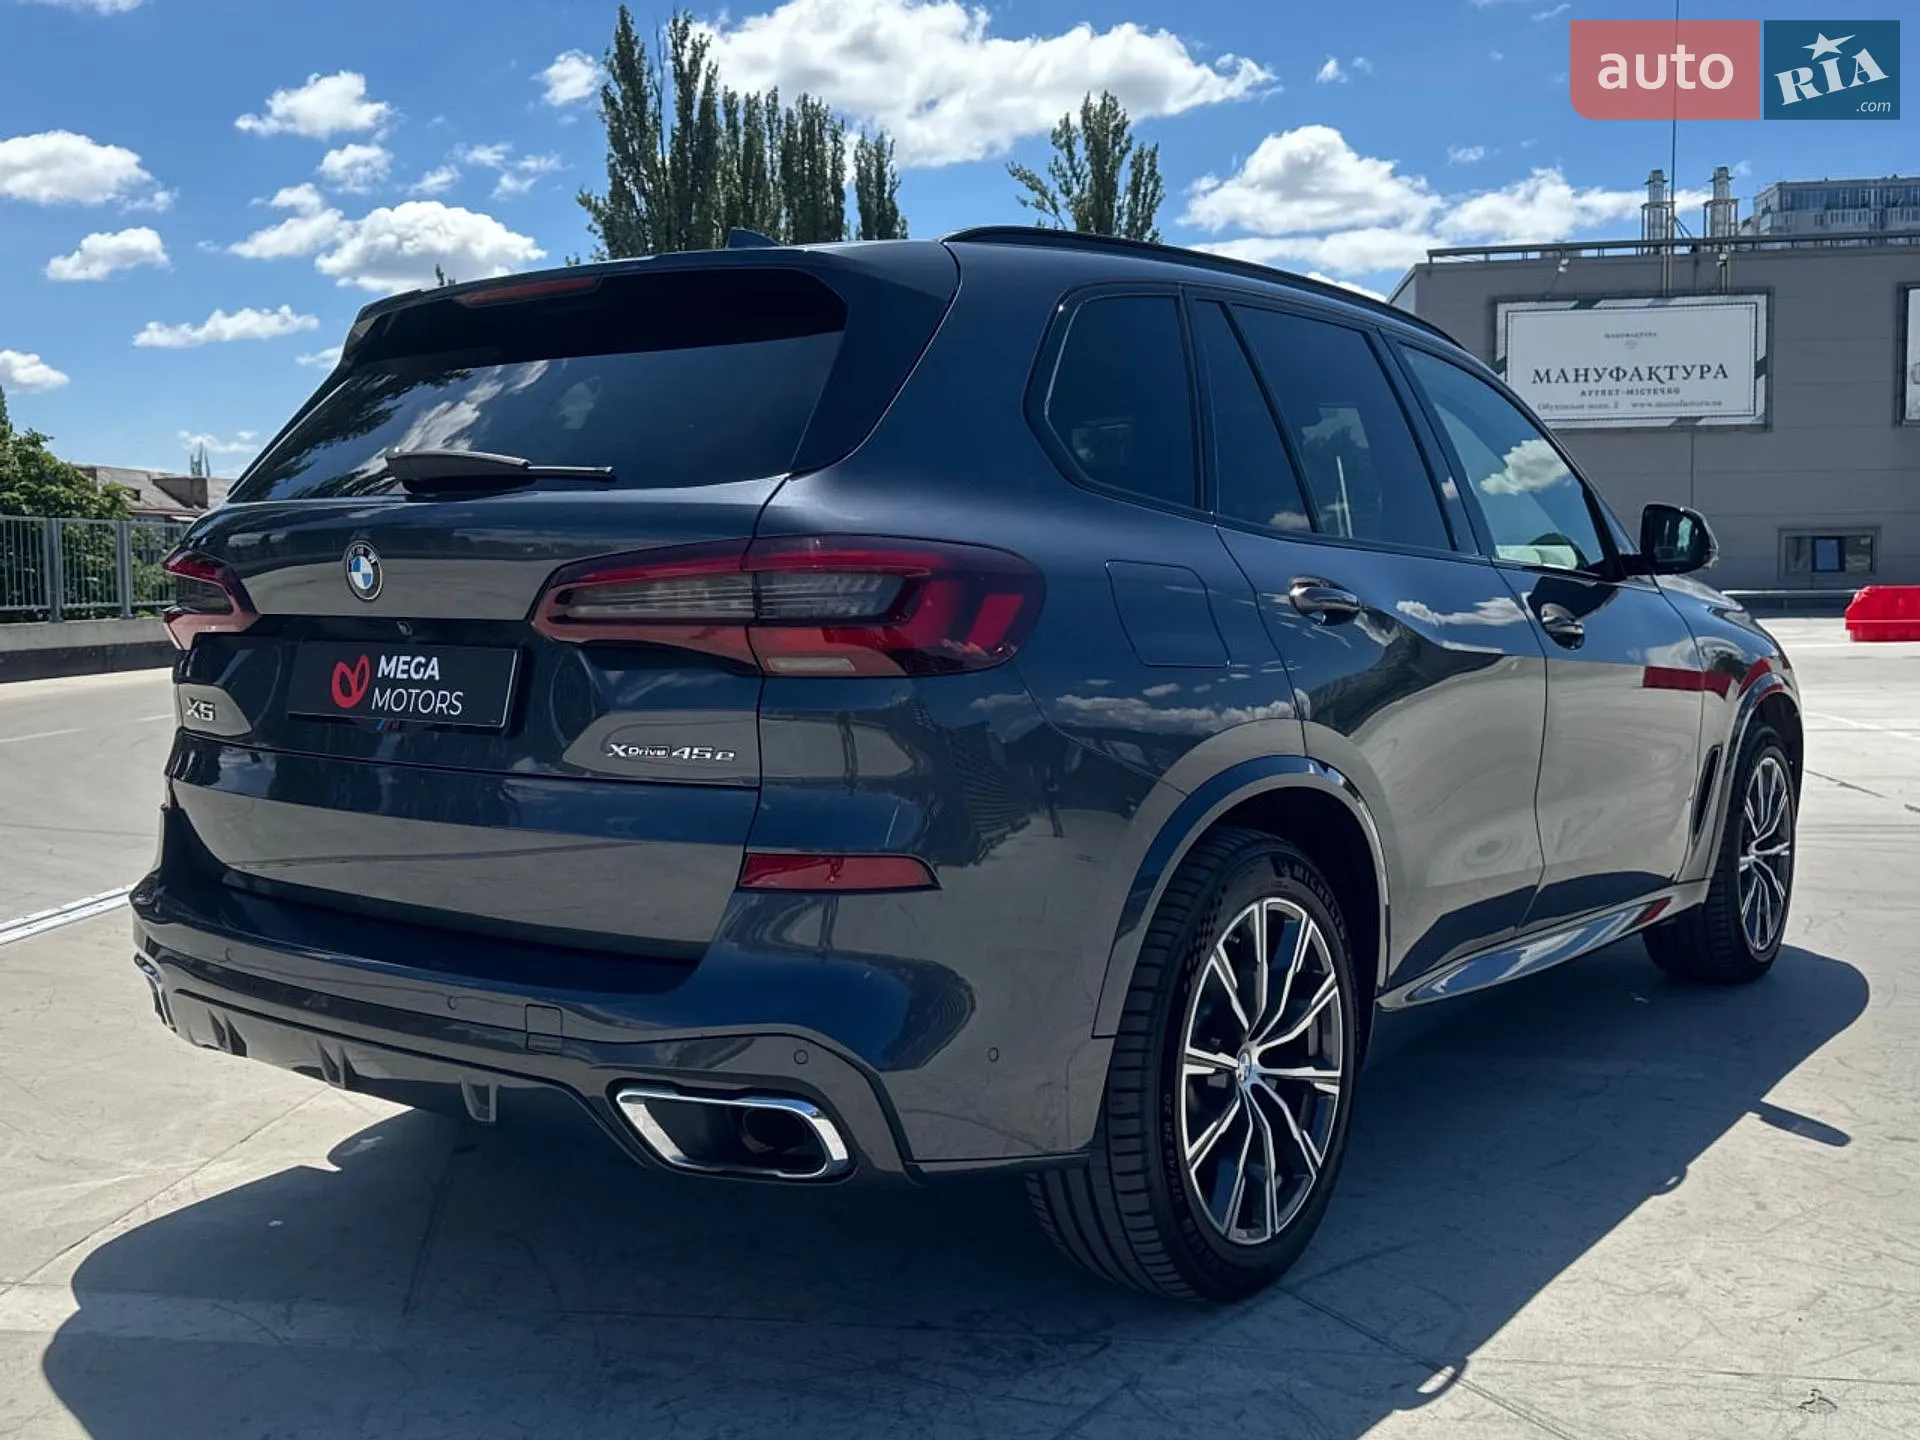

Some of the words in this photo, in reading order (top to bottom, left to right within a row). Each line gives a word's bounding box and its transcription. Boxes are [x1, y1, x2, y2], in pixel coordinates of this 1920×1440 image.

[1530, 362, 1730, 386] МАНУФАКТУРА
[377, 654, 440, 681] MEGA
[371, 687, 464, 716] MOTORS
